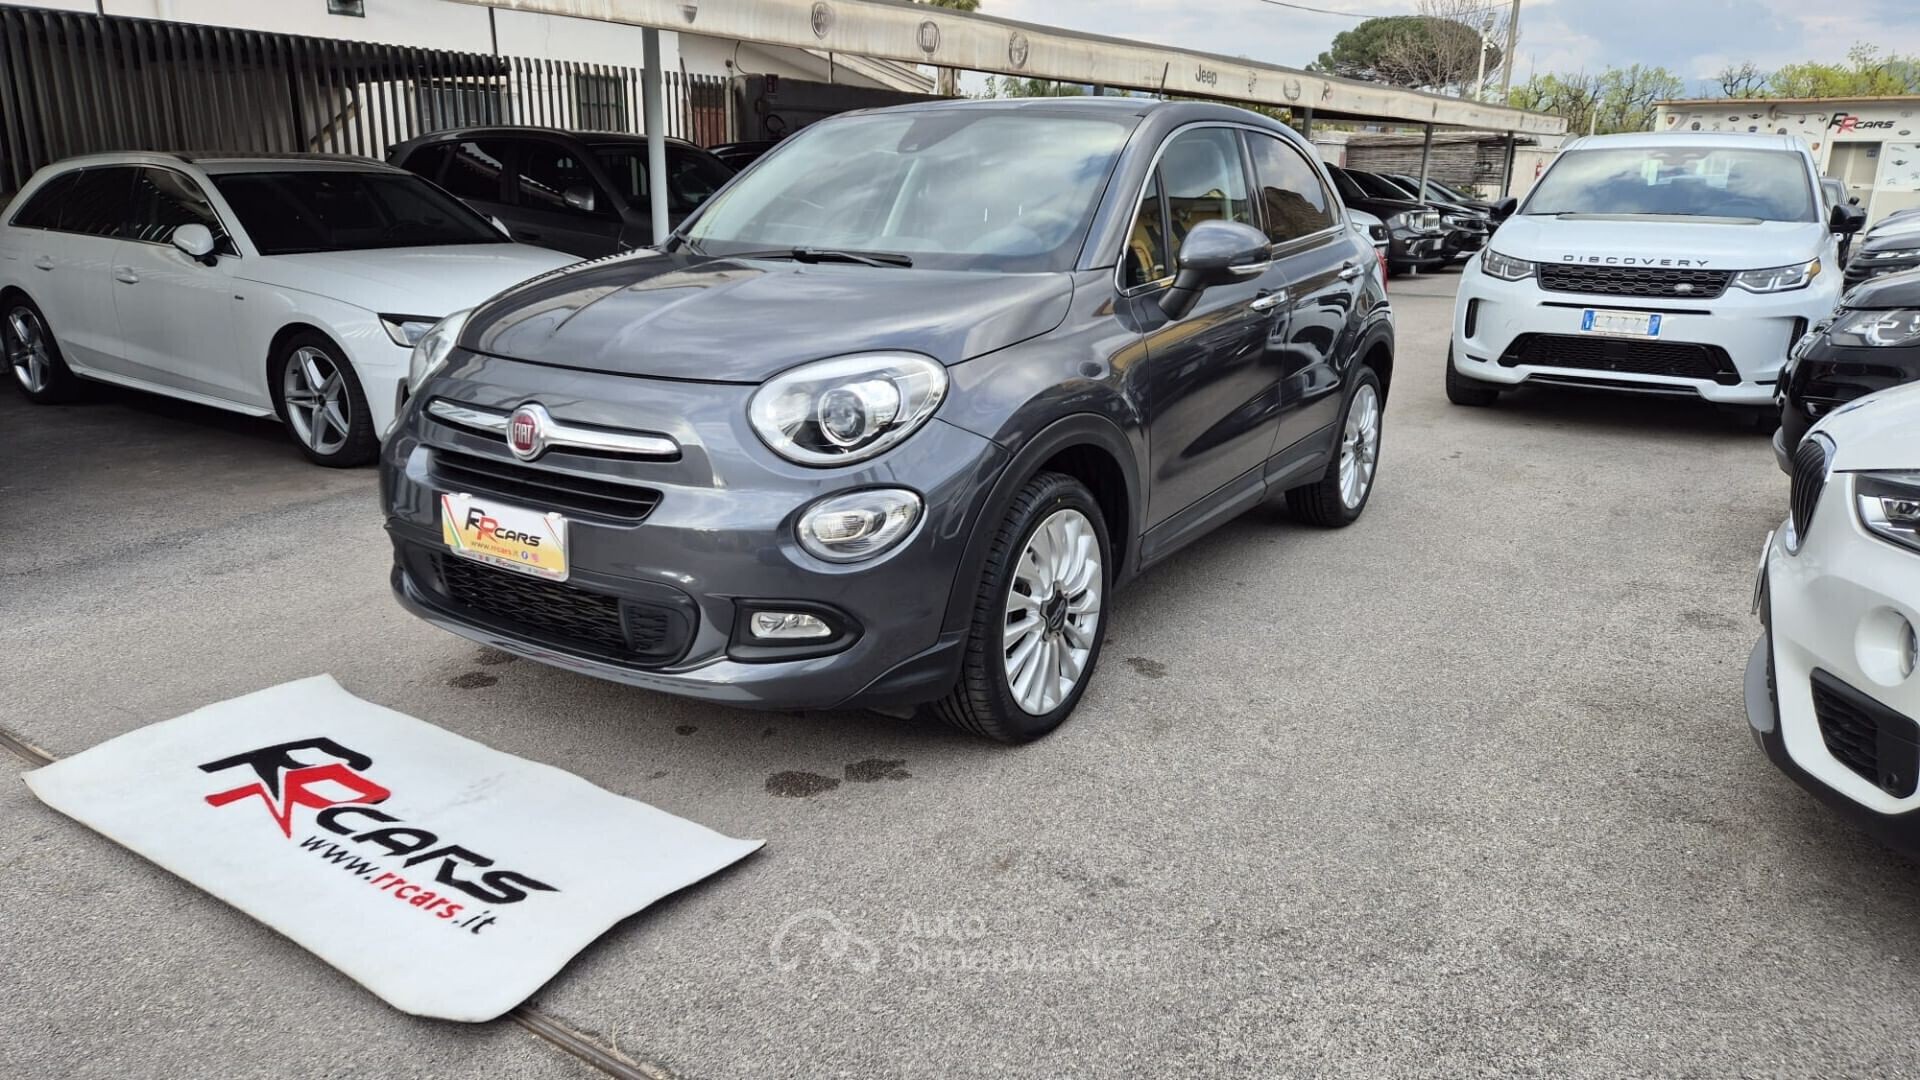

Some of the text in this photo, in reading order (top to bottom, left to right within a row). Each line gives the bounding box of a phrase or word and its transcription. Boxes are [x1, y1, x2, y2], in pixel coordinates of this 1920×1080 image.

[1195, 64, 1217, 88] Jeep
[1563, 255, 1709, 267] DISCOVERY
[514, 422, 535, 444] FIAT
[300, 835, 500, 934] www.rrcars.it
